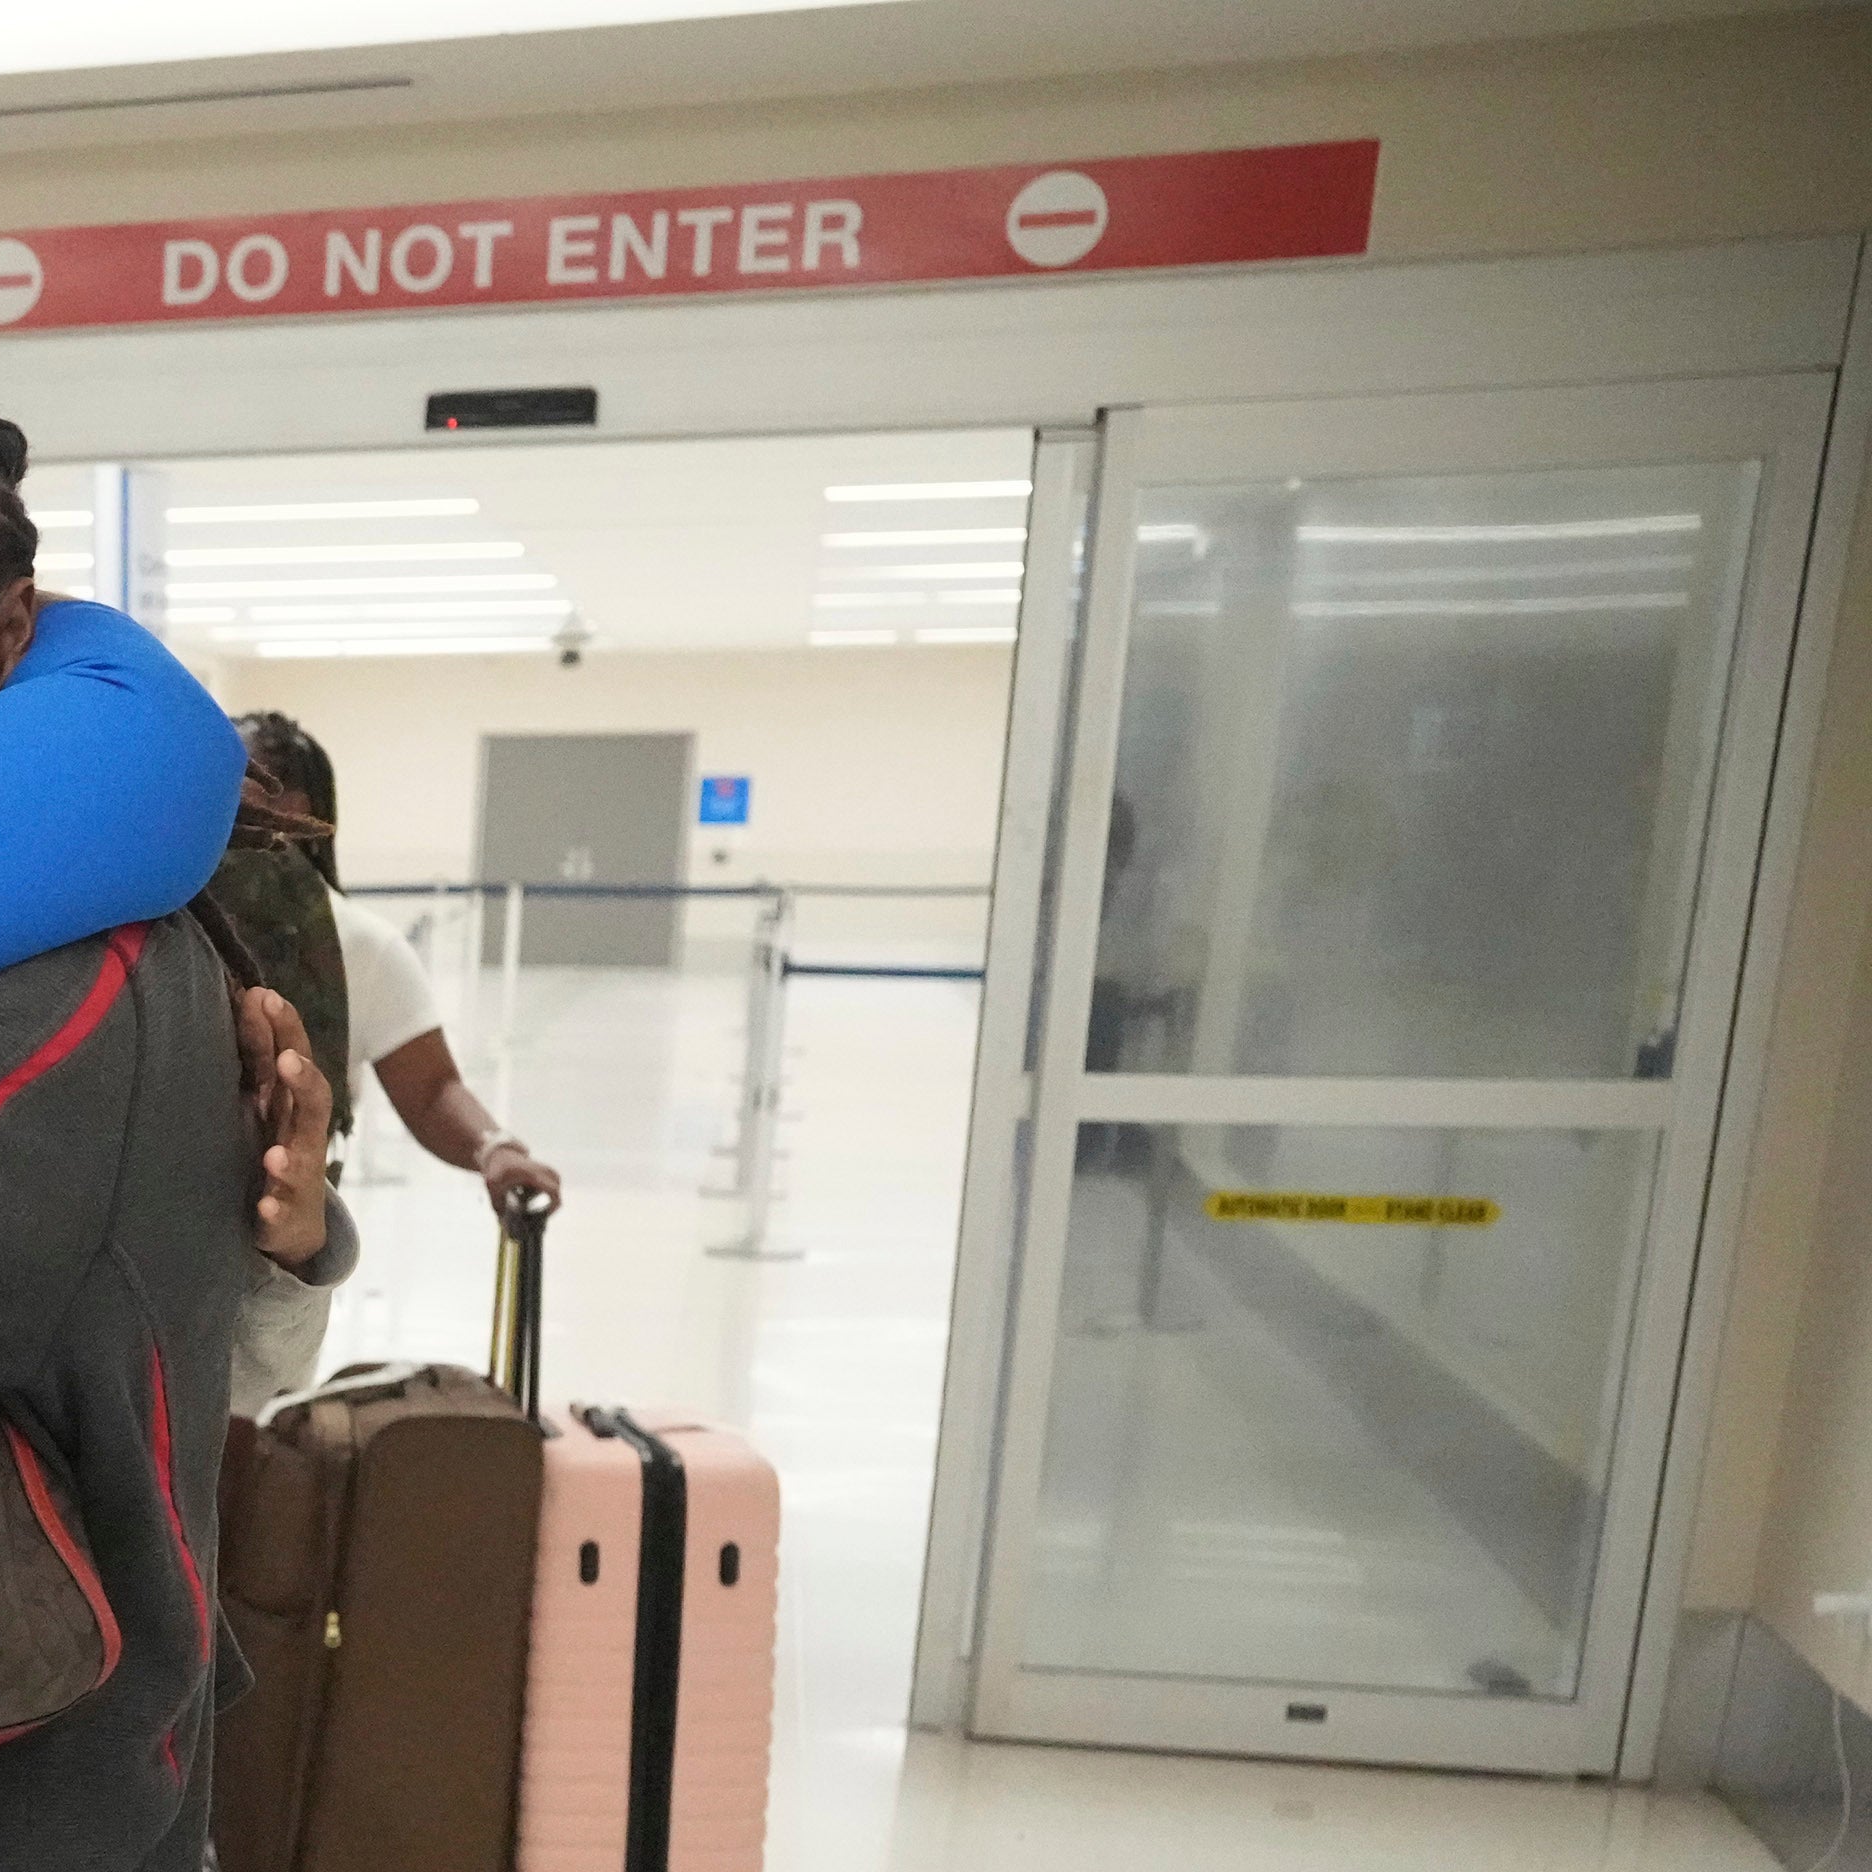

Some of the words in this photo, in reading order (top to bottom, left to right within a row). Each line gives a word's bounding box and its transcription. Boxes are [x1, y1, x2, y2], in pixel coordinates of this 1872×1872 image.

[163, 235, 289, 306] DO
[324, 221, 513, 297] NOT
[547, 200, 863, 285] ENTER
